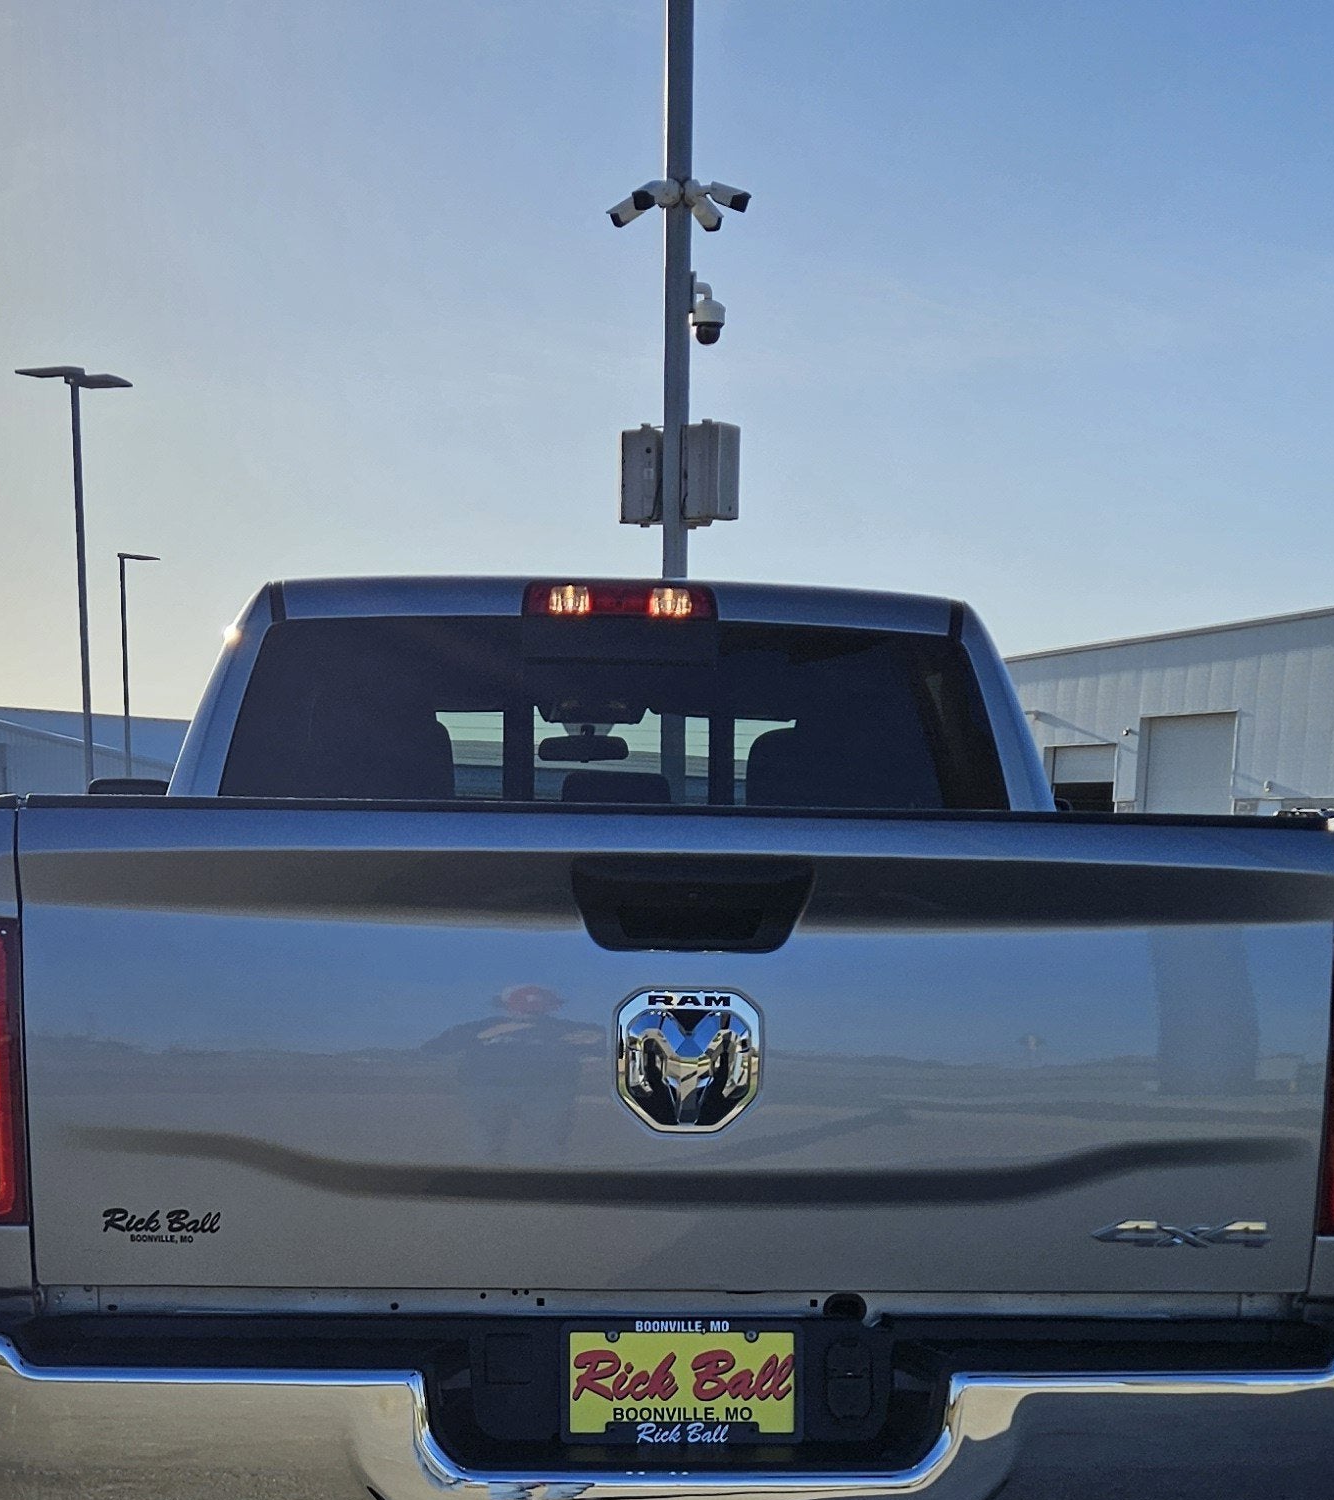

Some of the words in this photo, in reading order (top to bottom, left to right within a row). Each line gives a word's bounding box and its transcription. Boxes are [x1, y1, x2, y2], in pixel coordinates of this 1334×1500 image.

[647, 994, 731, 1007] RAM
[102, 1207, 162, 1233] Rick
[166, 1208, 222, 1234] Ball
[129, 1234, 178, 1244] BOONVILLE,
[180, 1234, 194, 1244] MO
[634, 1320, 707, 1334] BOONVILLE,
[710, 1320, 730, 1333] MO
[572, 1349, 679, 1401] Rick
[690, 1349, 795, 1401] Ball
[612, 1406, 721, 1422] BOONVILLE,
[725, 1406, 753, 1421] MO
[635, 1422, 682, 1444] Rick
[686, 1422, 730, 1444] Ball
